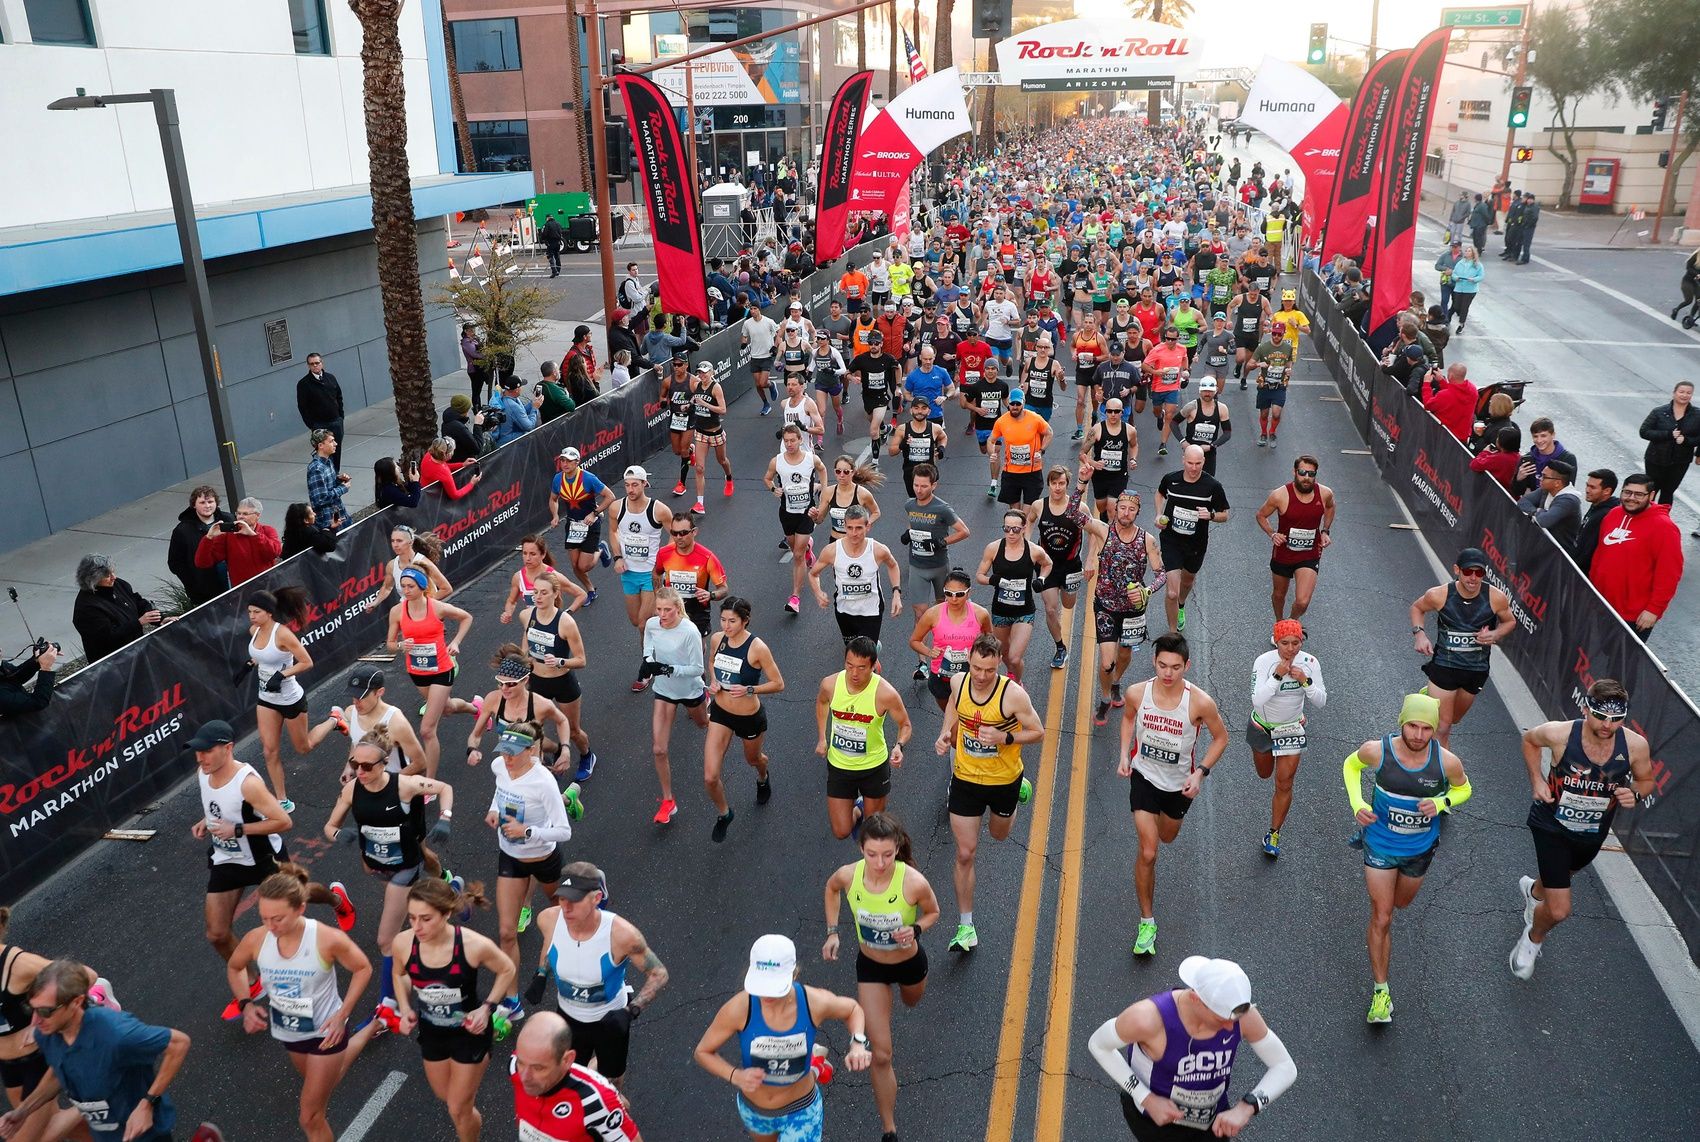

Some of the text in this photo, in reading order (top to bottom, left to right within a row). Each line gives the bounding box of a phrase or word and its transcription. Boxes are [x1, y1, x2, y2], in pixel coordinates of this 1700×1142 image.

[1475, 13, 1489, 22] St.
[1017, 40, 1093, 59] Rock
[1124, 38, 1189, 56] Roll
[1066, 66, 1128, 74] MARATHON
[1066, 80, 1127, 88] ARIZONA
[695, 91, 748, 100] 602 222 5000
[1259, 100, 1315, 112] Humana
[734, 115, 748, 123] 200
[836, 100, 851, 135] Roll
[906, 108, 954, 120] Humana
[1349, 136, 1366, 180] Rock
[1364, 82, 1384, 119] Roll
[642, 120, 658, 180] MARATHON
[1362, 123, 1379, 174] MARATHON
[1392, 151, 1407, 212] Rock
[1403, 77, 1422, 129] Roll
[841, 136, 852, 184] MARATHON
[876, 151, 910, 159] BROOKS
[649, 110, 668, 164] Rock
[664, 180, 680, 225] Roll
[830, 148, 845, 189] Rock
[1402, 132, 1418, 201] MARATHON
[1030, 370, 1049, 378] NRC
[981, 391, 1001, 399] WOOT!
[595, 424, 624, 446] Roll
[1412, 473, 1441, 508] MARATHON
[1442, 479, 1464, 516] Roll
[432, 508, 479, 543] Rock
[489, 480, 522, 512] Roll
[1173, 518, 1195, 529] 10179
[1060, 526, 1072, 535] CITY
[443, 521, 492, 558] MARATHON
[1289, 538, 1315, 546] 10022
[625, 545, 648, 554] 10040
[1480, 528, 1508, 578] Rock
[1517, 572, 1548, 622] Roll
[340, 562, 385, 604] Roll
[670, 582, 696, 591] 10025
[842, 584, 872, 593] 10050
[1003, 590, 1021, 599] 260
[1448, 635, 1476, 644] 1002
[534, 644, 546, 652] 96
[720, 671, 732, 680] 77
[1144, 713, 1183, 728] NORTHERN
[1142, 722, 1182, 736] HIGHLANDS
[834, 736, 865, 750] 10013
[1273, 736, 1306, 746] 10229
[0, 748, 94, 815] Rock
[113, 682, 188, 743] Roll
[1144, 745, 1176, 760] 12318
[1564, 775, 1604, 791] DENVER
[9, 756, 119, 838] MARATHON
[1389, 812, 1432, 825] 10030
[1559, 806, 1603, 820] 10079
[373, 843, 388, 854] 95
[872, 929, 889, 941] 79
[261, 968, 316, 976] STRAWBERRY
[572, 986, 590, 999] 74
[768, 1060, 790, 1071] 94
[1178, 1050, 1232, 1076] GCU
[1173, 1066, 1231, 1082] RUNNING CLUB
